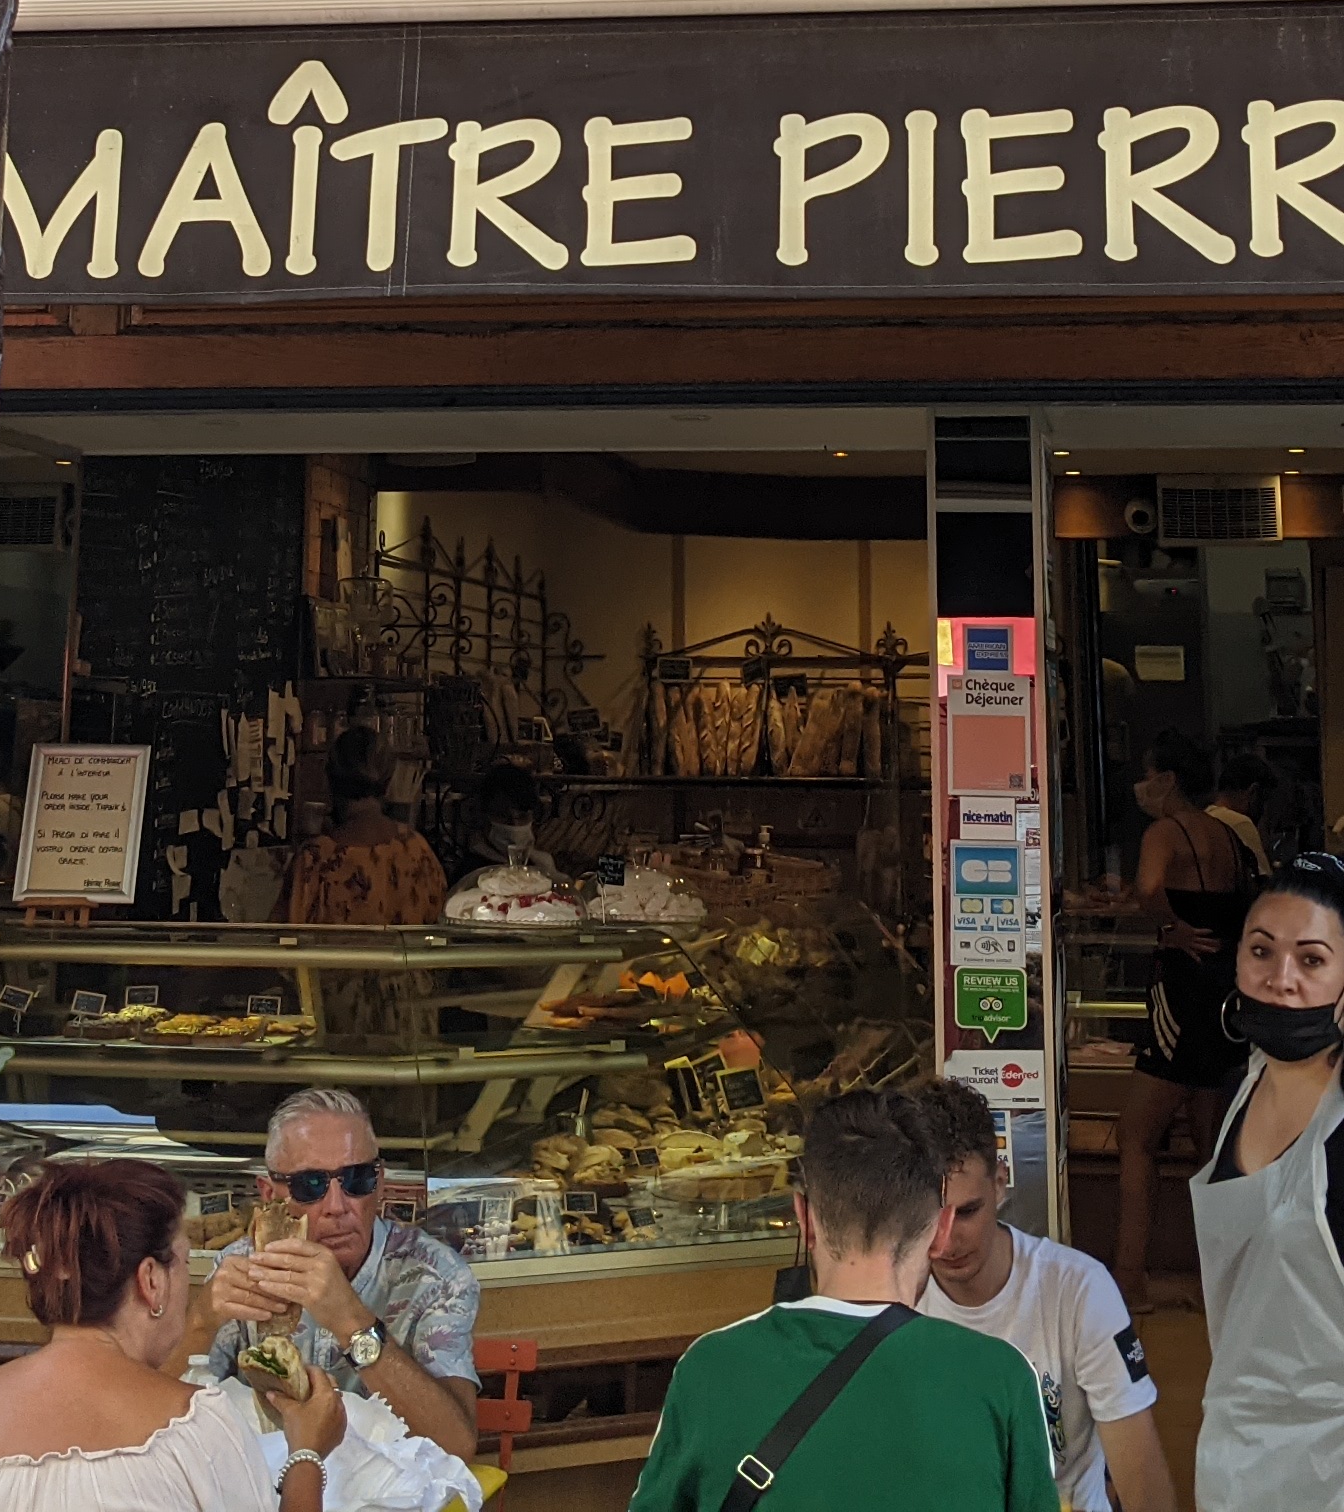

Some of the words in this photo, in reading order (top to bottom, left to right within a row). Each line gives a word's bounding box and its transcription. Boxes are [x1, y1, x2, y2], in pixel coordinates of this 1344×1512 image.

[2, 59, 699, 280] MAÎTRE
[965, 678, 1015, 694] Chèque
[965, 692, 1024, 707] Déjeuner
[962, 810, 1013, 824] nice-matin
[963, 975, 1001, 986] REVIEW
[1005, 976, 1019, 986] US
[972, 1067, 998, 1076] Ticket
